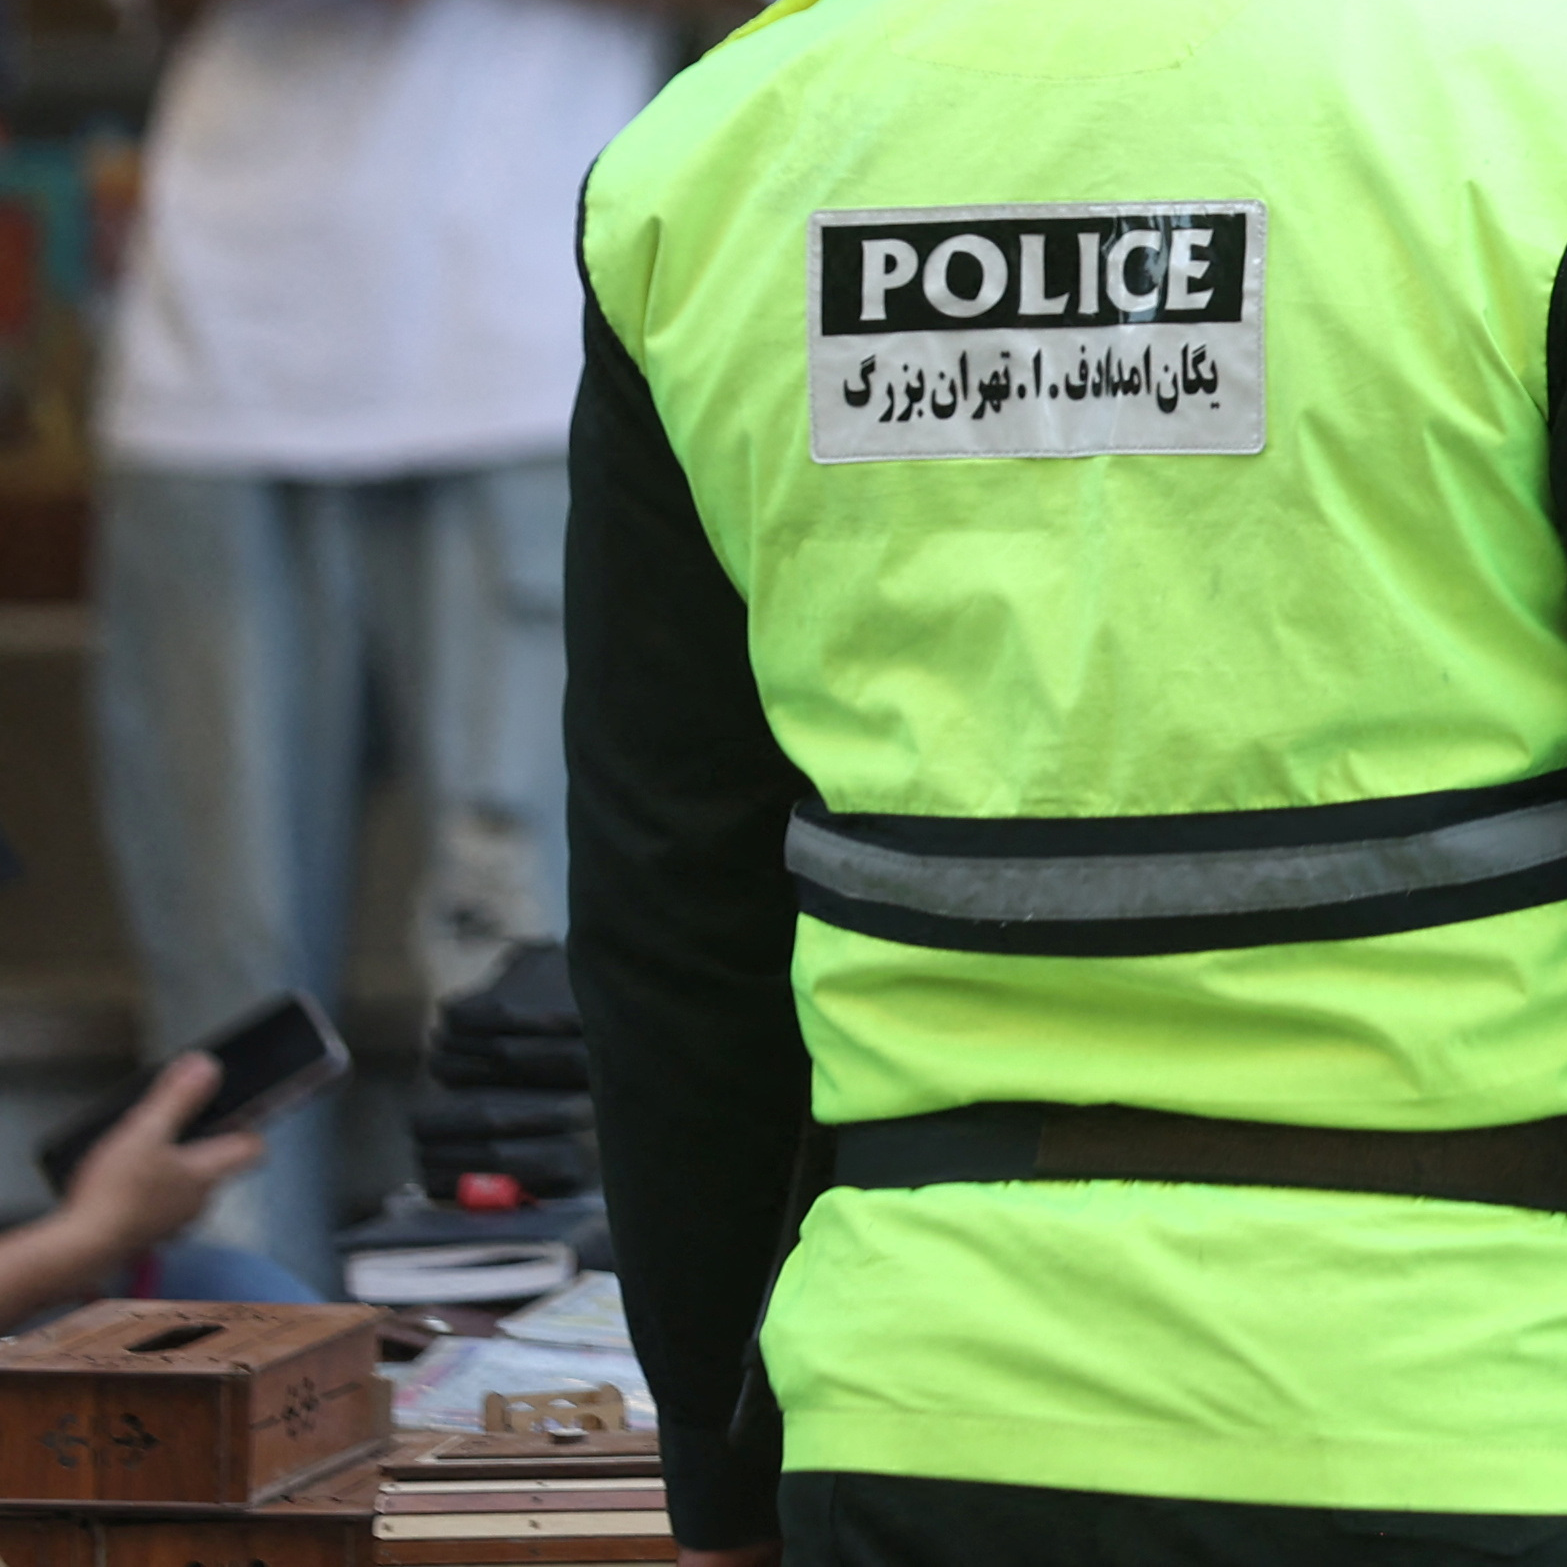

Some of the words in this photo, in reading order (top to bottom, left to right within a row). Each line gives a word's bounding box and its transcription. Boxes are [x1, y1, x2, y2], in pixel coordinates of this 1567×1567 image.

[861, 229, 1214, 322] POLICE
[843, 355, 925, 423] بزرگ
[931, 351, 1012, 420] تهران
[1157, 345, 1220, 414] یگان
